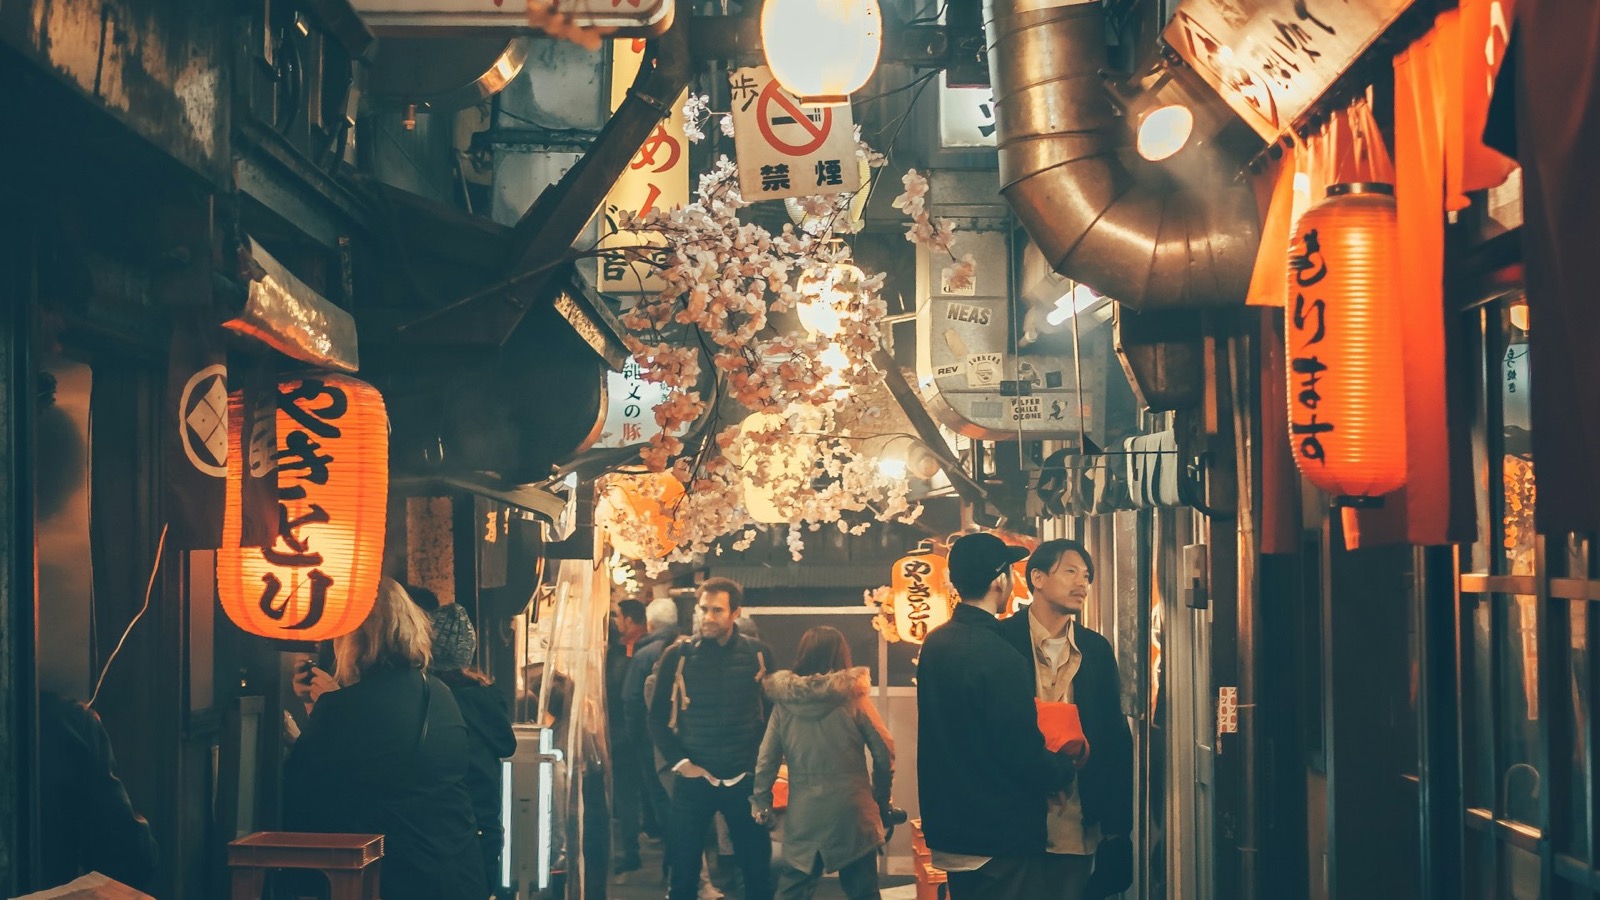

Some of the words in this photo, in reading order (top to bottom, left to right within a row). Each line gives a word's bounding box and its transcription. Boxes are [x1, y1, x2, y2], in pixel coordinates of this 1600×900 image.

[760, 159, 843, 192] 禁煙
[947, 303, 990, 325] NEAS
[937, 365, 959, 375] REV
[1010, 398, 1040, 407] PLFER
[259, 379, 348, 630] やきとり
[904, 560, 931, 641] やきとり
